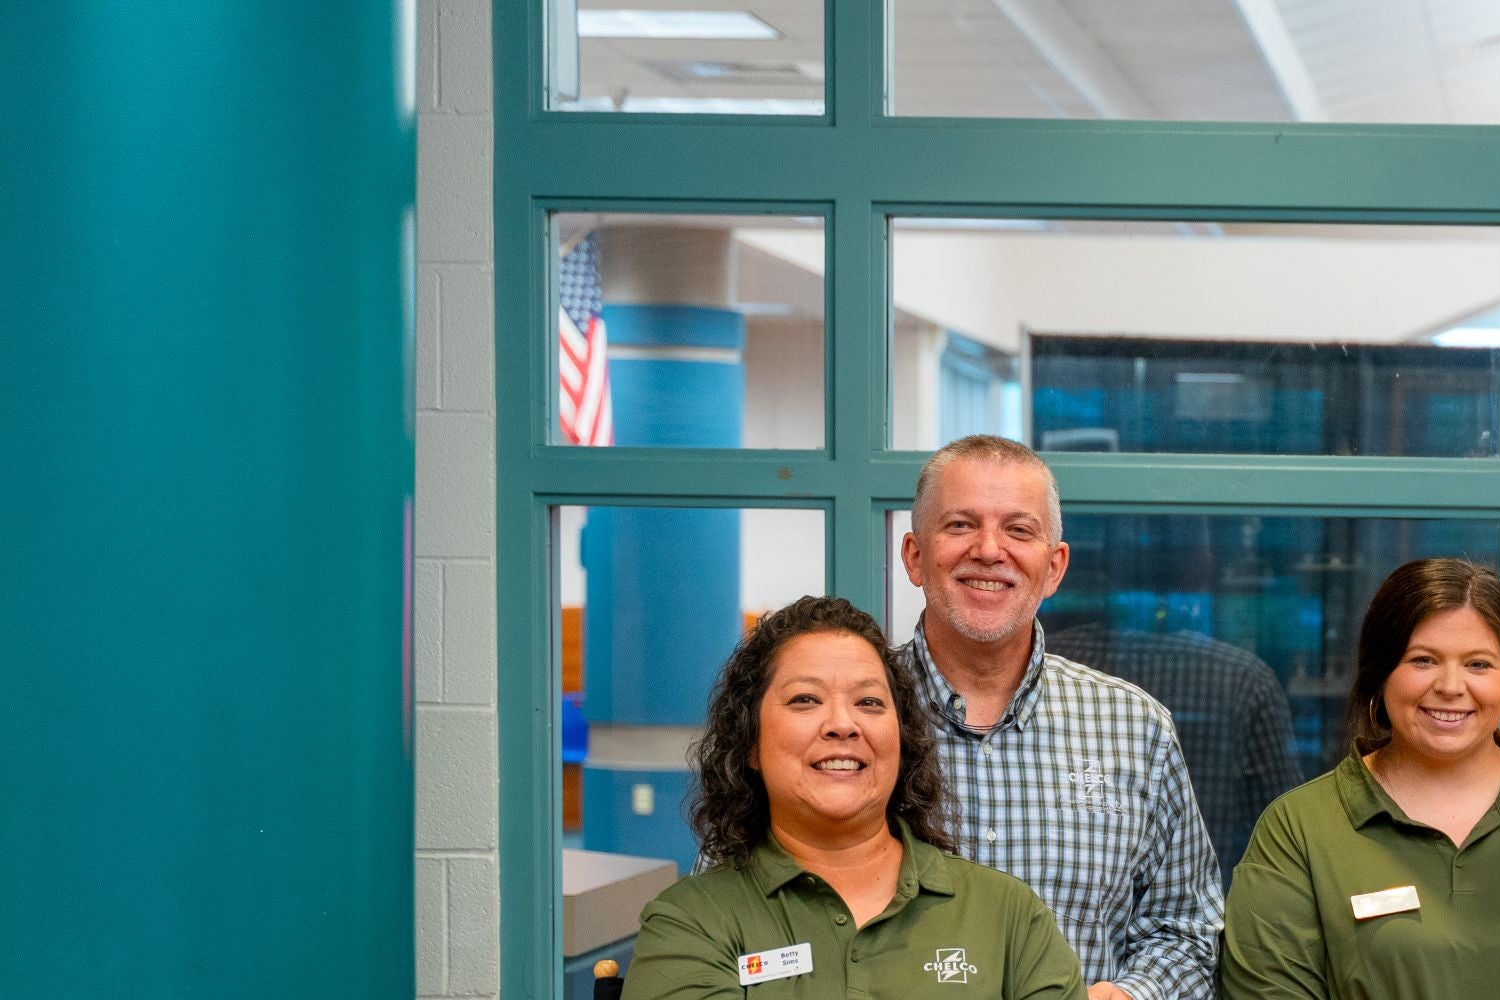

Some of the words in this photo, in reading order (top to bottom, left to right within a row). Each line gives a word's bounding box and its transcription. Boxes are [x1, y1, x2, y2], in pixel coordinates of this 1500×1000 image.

[780, 951, 798, 960] Betty
[782, 958, 799, 967] Sims
[923, 962, 977, 974] CHELCO
